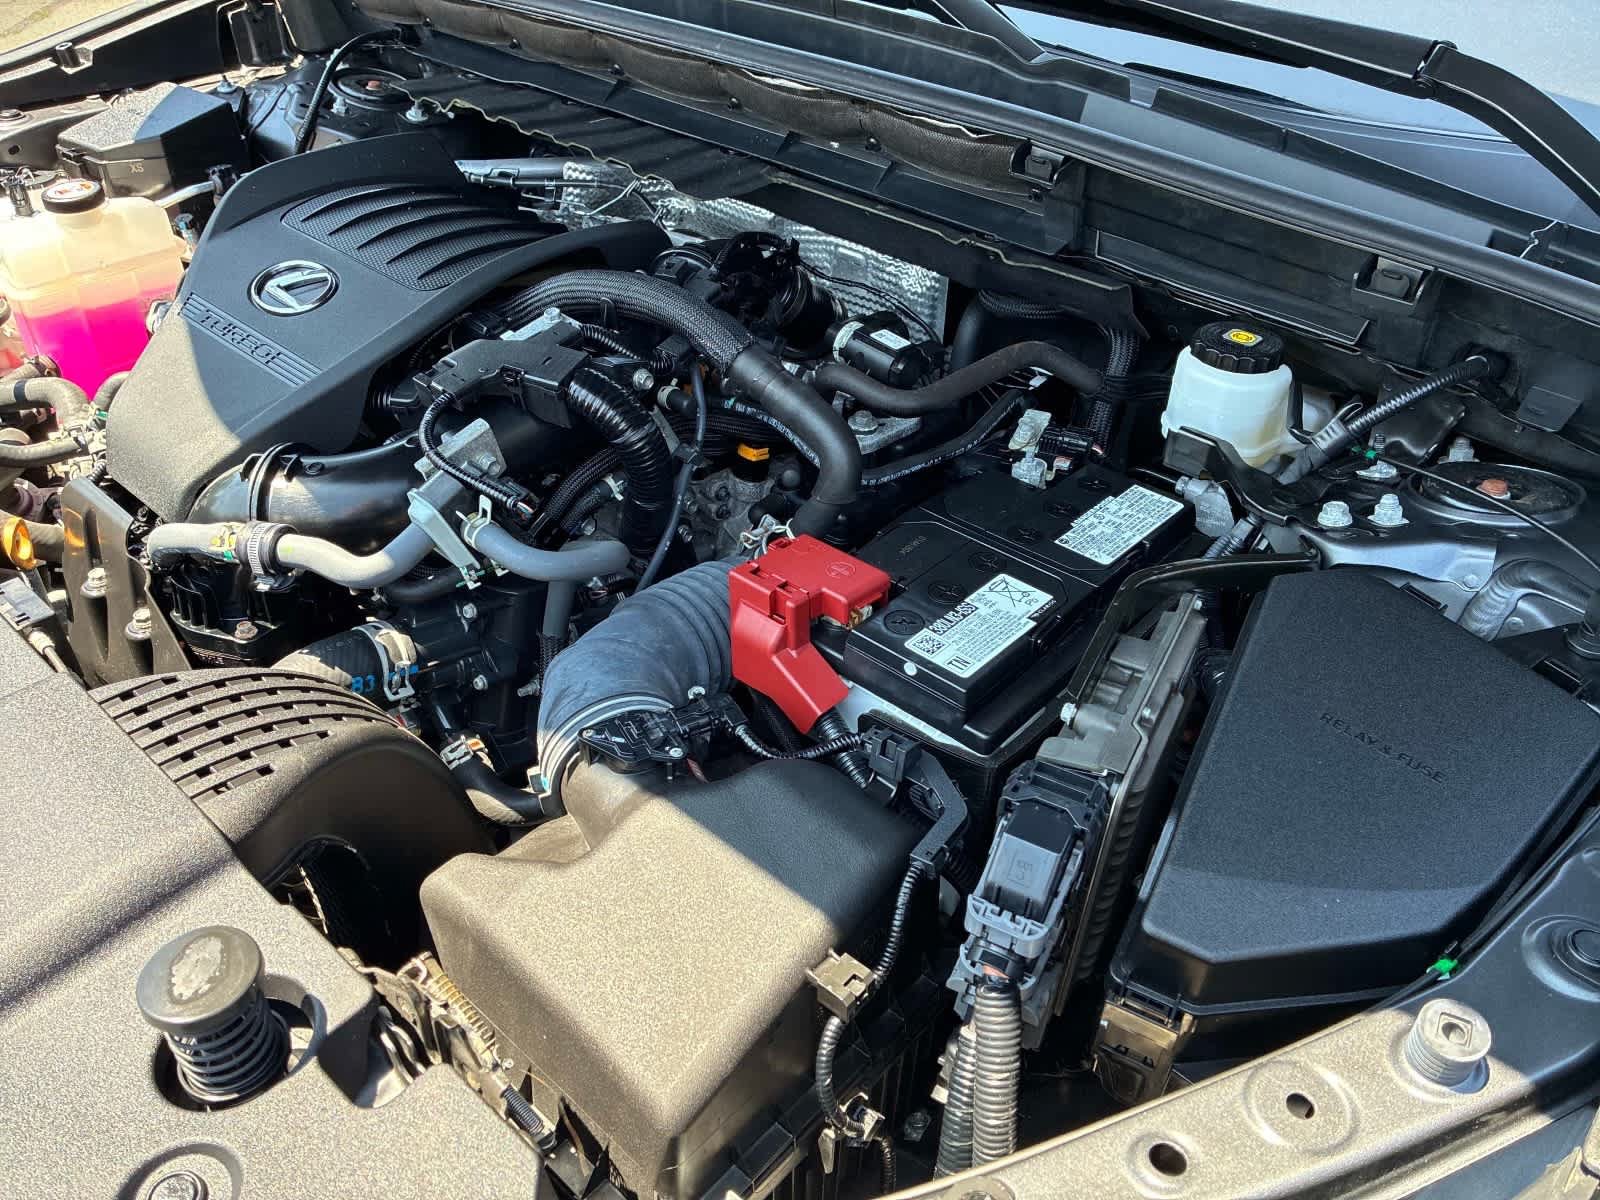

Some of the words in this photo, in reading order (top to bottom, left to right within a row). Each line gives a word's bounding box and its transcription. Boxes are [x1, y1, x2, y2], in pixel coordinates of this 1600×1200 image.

[200, 308, 276, 359] TURBO
[946, 655, 972, 670] TN
[1319, 712, 1378, 746] RELAY
[1398, 752, 1447, 783] FUSE
